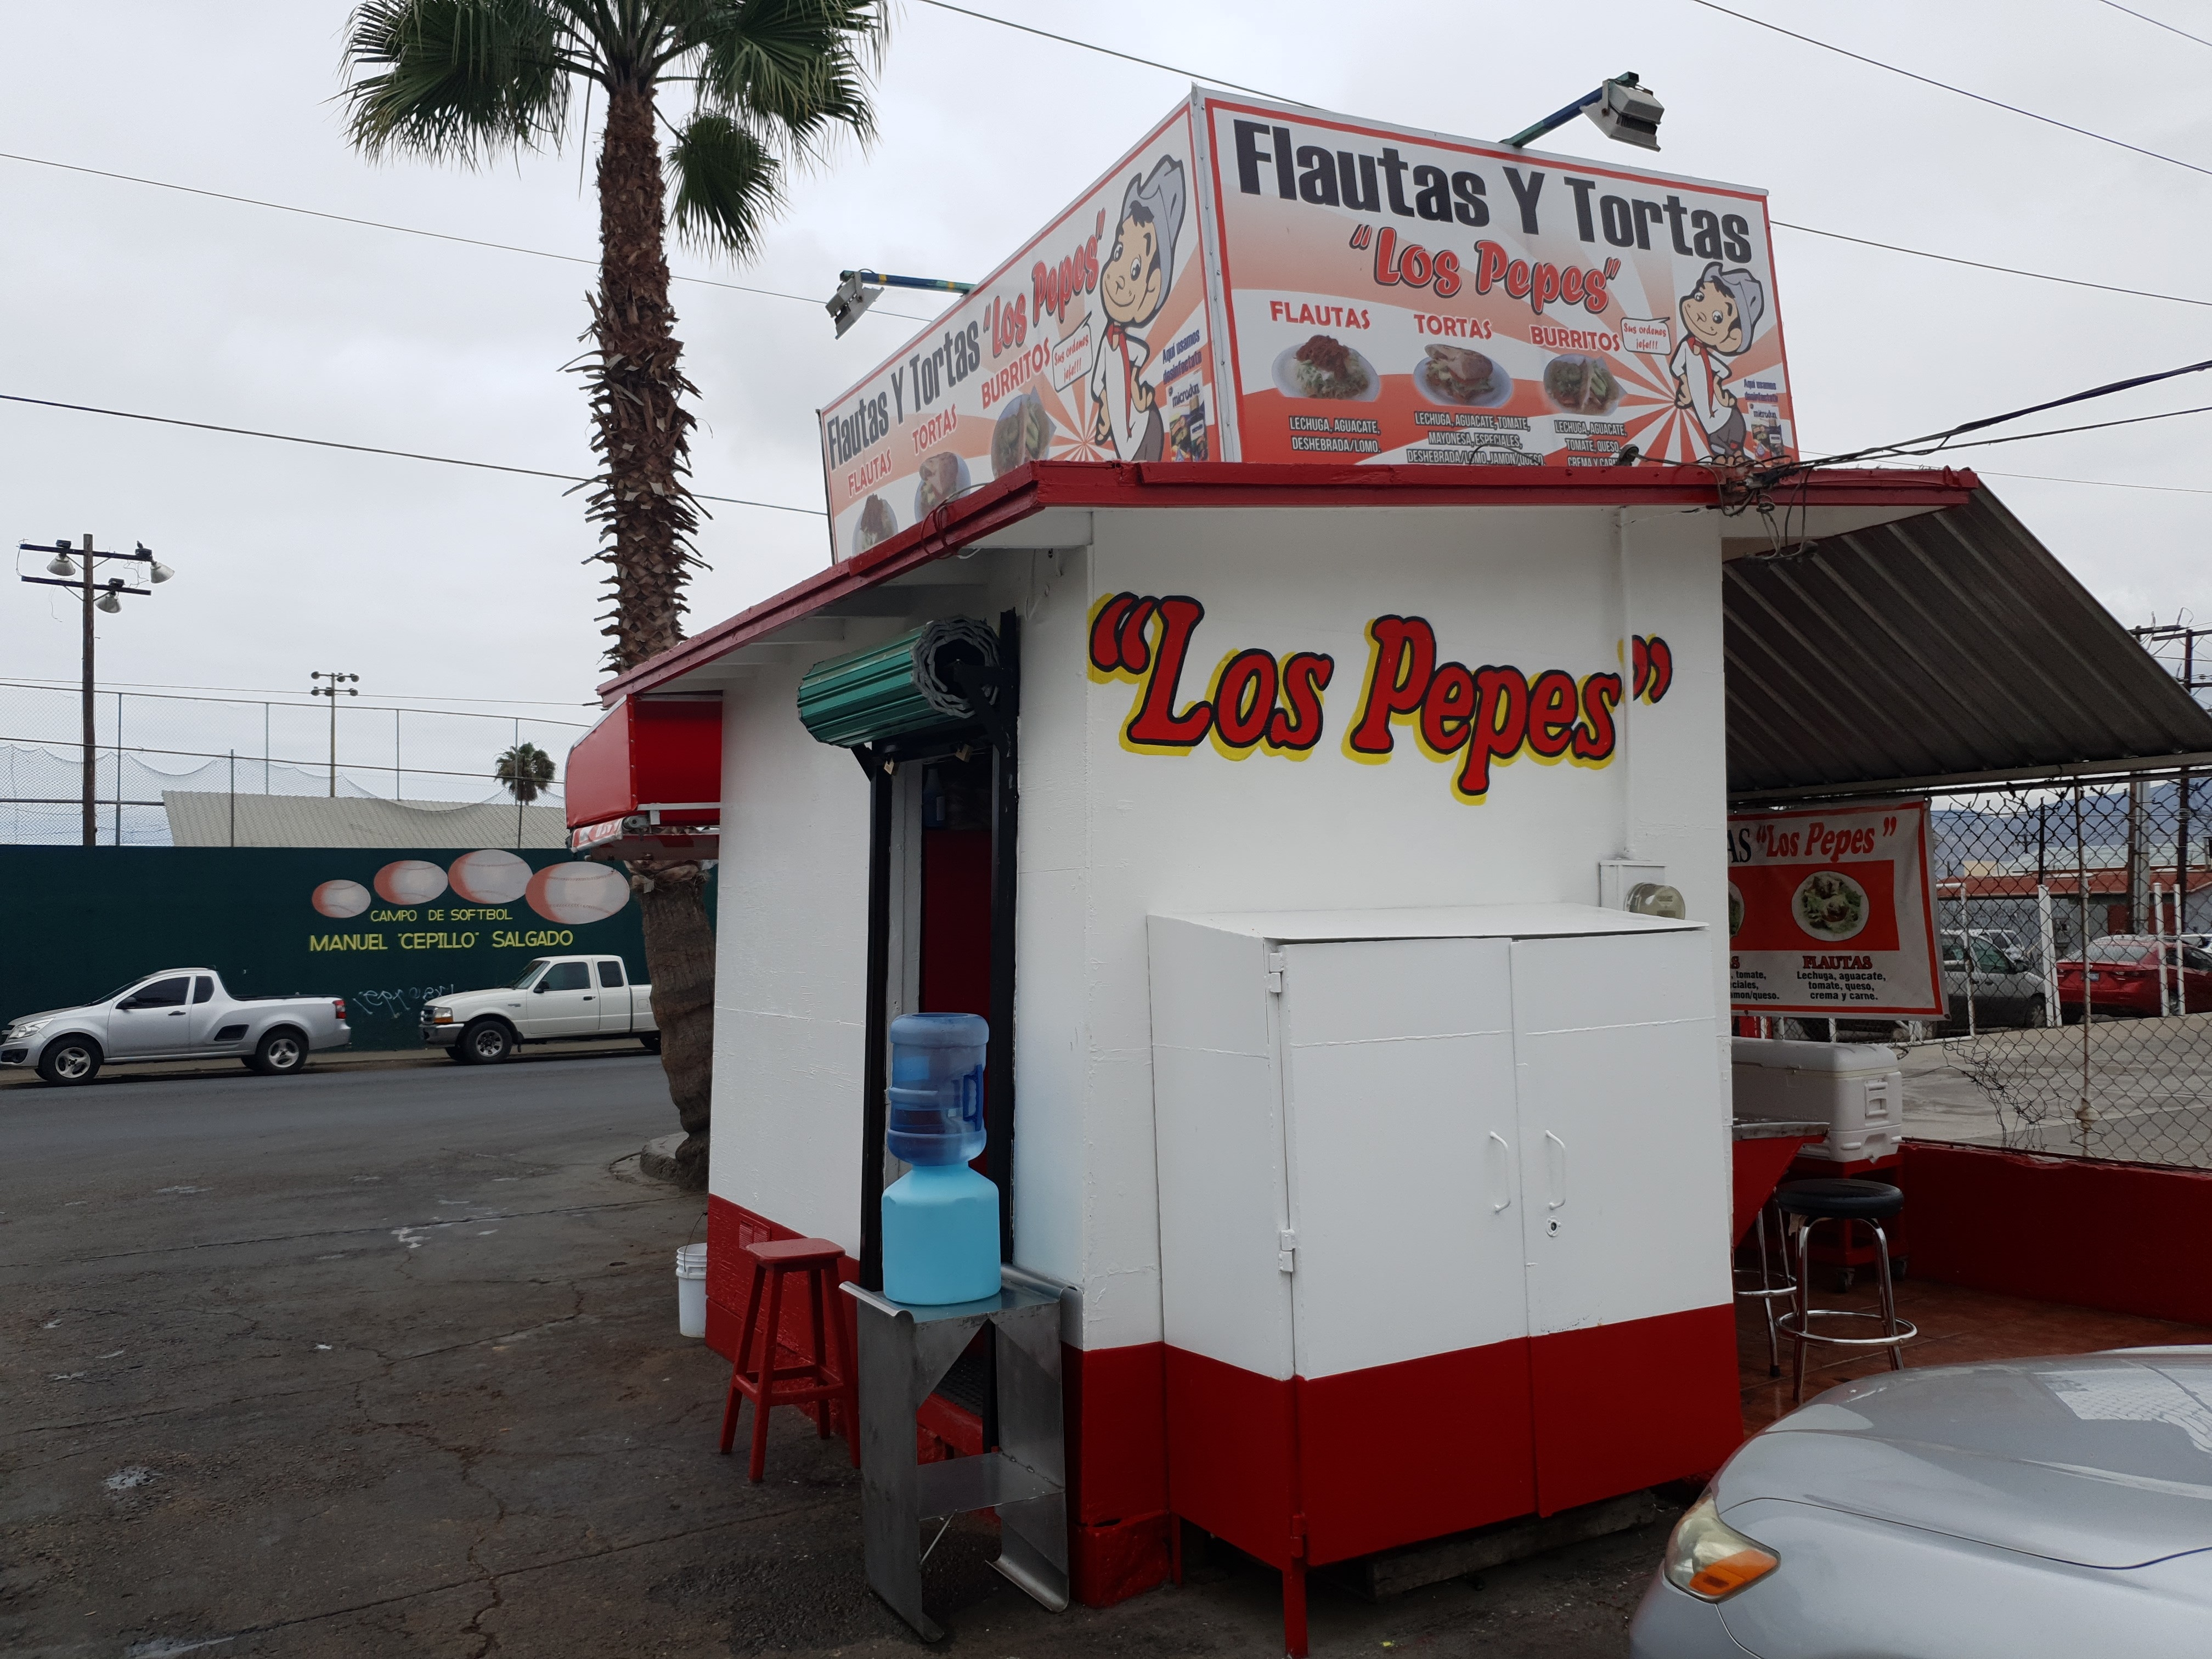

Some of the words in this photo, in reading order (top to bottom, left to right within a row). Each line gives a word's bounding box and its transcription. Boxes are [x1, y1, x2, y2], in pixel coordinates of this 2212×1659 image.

[1233, 119, 1490, 229] Flautas
[1502, 165, 1545, 235] Y
[1564, 176, 1752, 264] Tortas
[1350, 224, 1462, 298] "Los
[1474, 239, 1620, 314] Pepes"
[1269, 301, 1370, 330] FLAUTAS
[1414, 314, 1492, 340] TORTAS
[1623, 322, 1637, 334] Sus
[1639, 325, 1667, 337] ordenes
[1176, 329, 1200, 354] usamos
[1530, 325, 1620, 352] BURRITOS
[1054, 352, 1065, 366] Sus
[1066, 334, 1089, 357] ordenes
[981, 337, 1051, 410] BURRITOS
[827, 391, 890, 471] Flautas
[890, 365, 904, 425] Y
[909, 320, 981, 413] Tortas
[912, 403, 958, 455] TORTAS
[1289, 416, 1333, 432] LECHUGA,
[1334, 419, 1380, 435] AGUACATE,
[1415, 413, 1454, 427] LECHUGA,
[1455, 414, 1497, 430] AGUACATE,
[1498, 416, 1531, 431] TOMATE,
[1555, 420, 1589, 435] LECHUGA,
[1590, 422, 1627, 436] AGUACATE,
[1292, 437, 1381, 453] DESHEBRADA/LOMO.
[1428, 432, 1475, 447] MAYONESA,
[1475, 434, 1523, 449] ESPECIALES,
[1566, 439, 1596, 453] TOMATE,
[1593, 458, 1599, 466] Y
[848, 448, 893, 498] FLAUTAS
[1088, 591, 1334, 761] "Los
[1756, 824, 1800, 857] "Los
[370, 909, 417, 922] CAMPO
[428, 909, 444, 922] DE
[450, 909, 514, 922] SOFTBOL
[309, 934, 388, 952] MANUEL
[397, 932, 479, 950] "CEPILLO"
[492, 930, 574, 947] SALGADO
[1803, 955, 1873, 969] FLAUTAS
[1736, 970, 1767, 980] tomate,
[1796, 971, 1836, 981] Lechuga,
[1838, 972, 1886, 981] aguacate,
[1730, 980, 1759, 990] ciales,
[1808, 981, 1843, 990] tomate,
[1844, 983, 1875, 991] queso,
[1842, 993, 1847, 1001] y
[1849, 992, 1878, 1001] carne.
